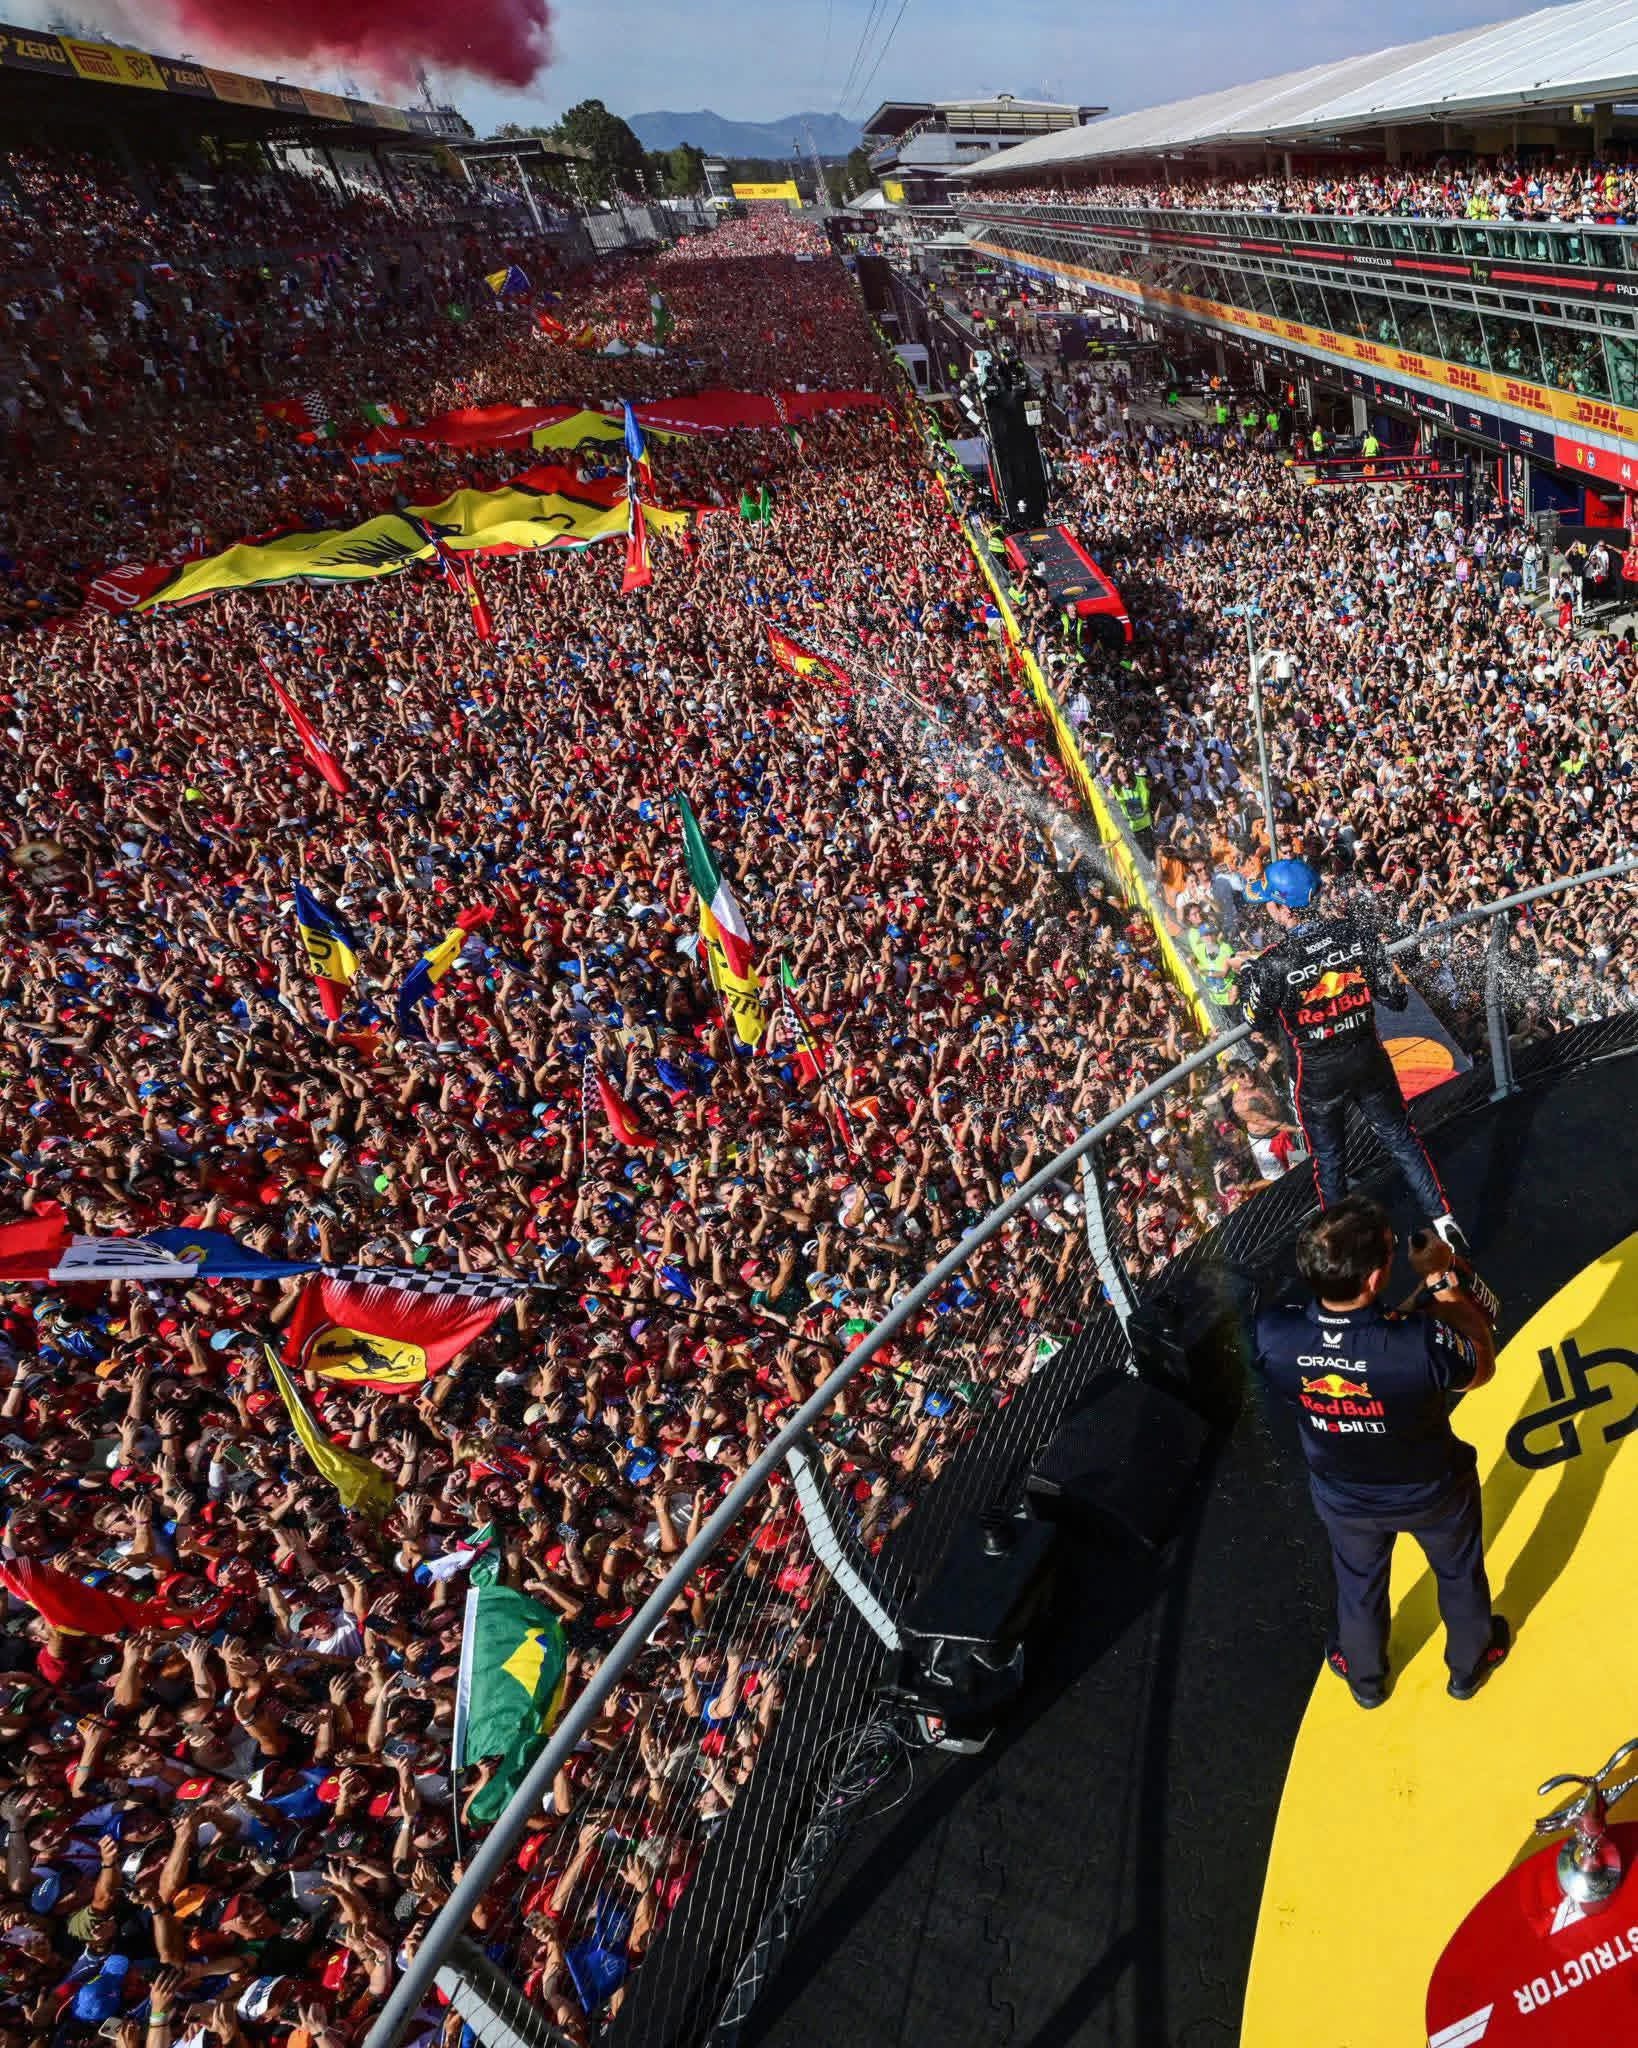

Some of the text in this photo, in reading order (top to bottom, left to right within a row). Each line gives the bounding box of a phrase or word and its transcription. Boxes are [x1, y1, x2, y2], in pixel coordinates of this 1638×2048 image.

[13, 39, 67, 63] ZERO
[1317, 333, 1344, 352] DHL
[1354, 342, 1385, 364] DHL
[1397, 353, 1431, 378] DHL
[1446, 366, 1482, 391] DHL
[1505, 382, 1548, 410] DHL
[1576, 401, 1625, 433] DHL
[1287, 942, 1364, 985] ORACLE
[1297, 998, 1339, 1025] Red
[1308, 1016, 1354, 1040] Mobil
[1297, 1355, 1367, 1372] ORACLE
[1299, 1394, 1384, 1416] Red Bull
[1310, 1415, 1364, 1433] Mobil
